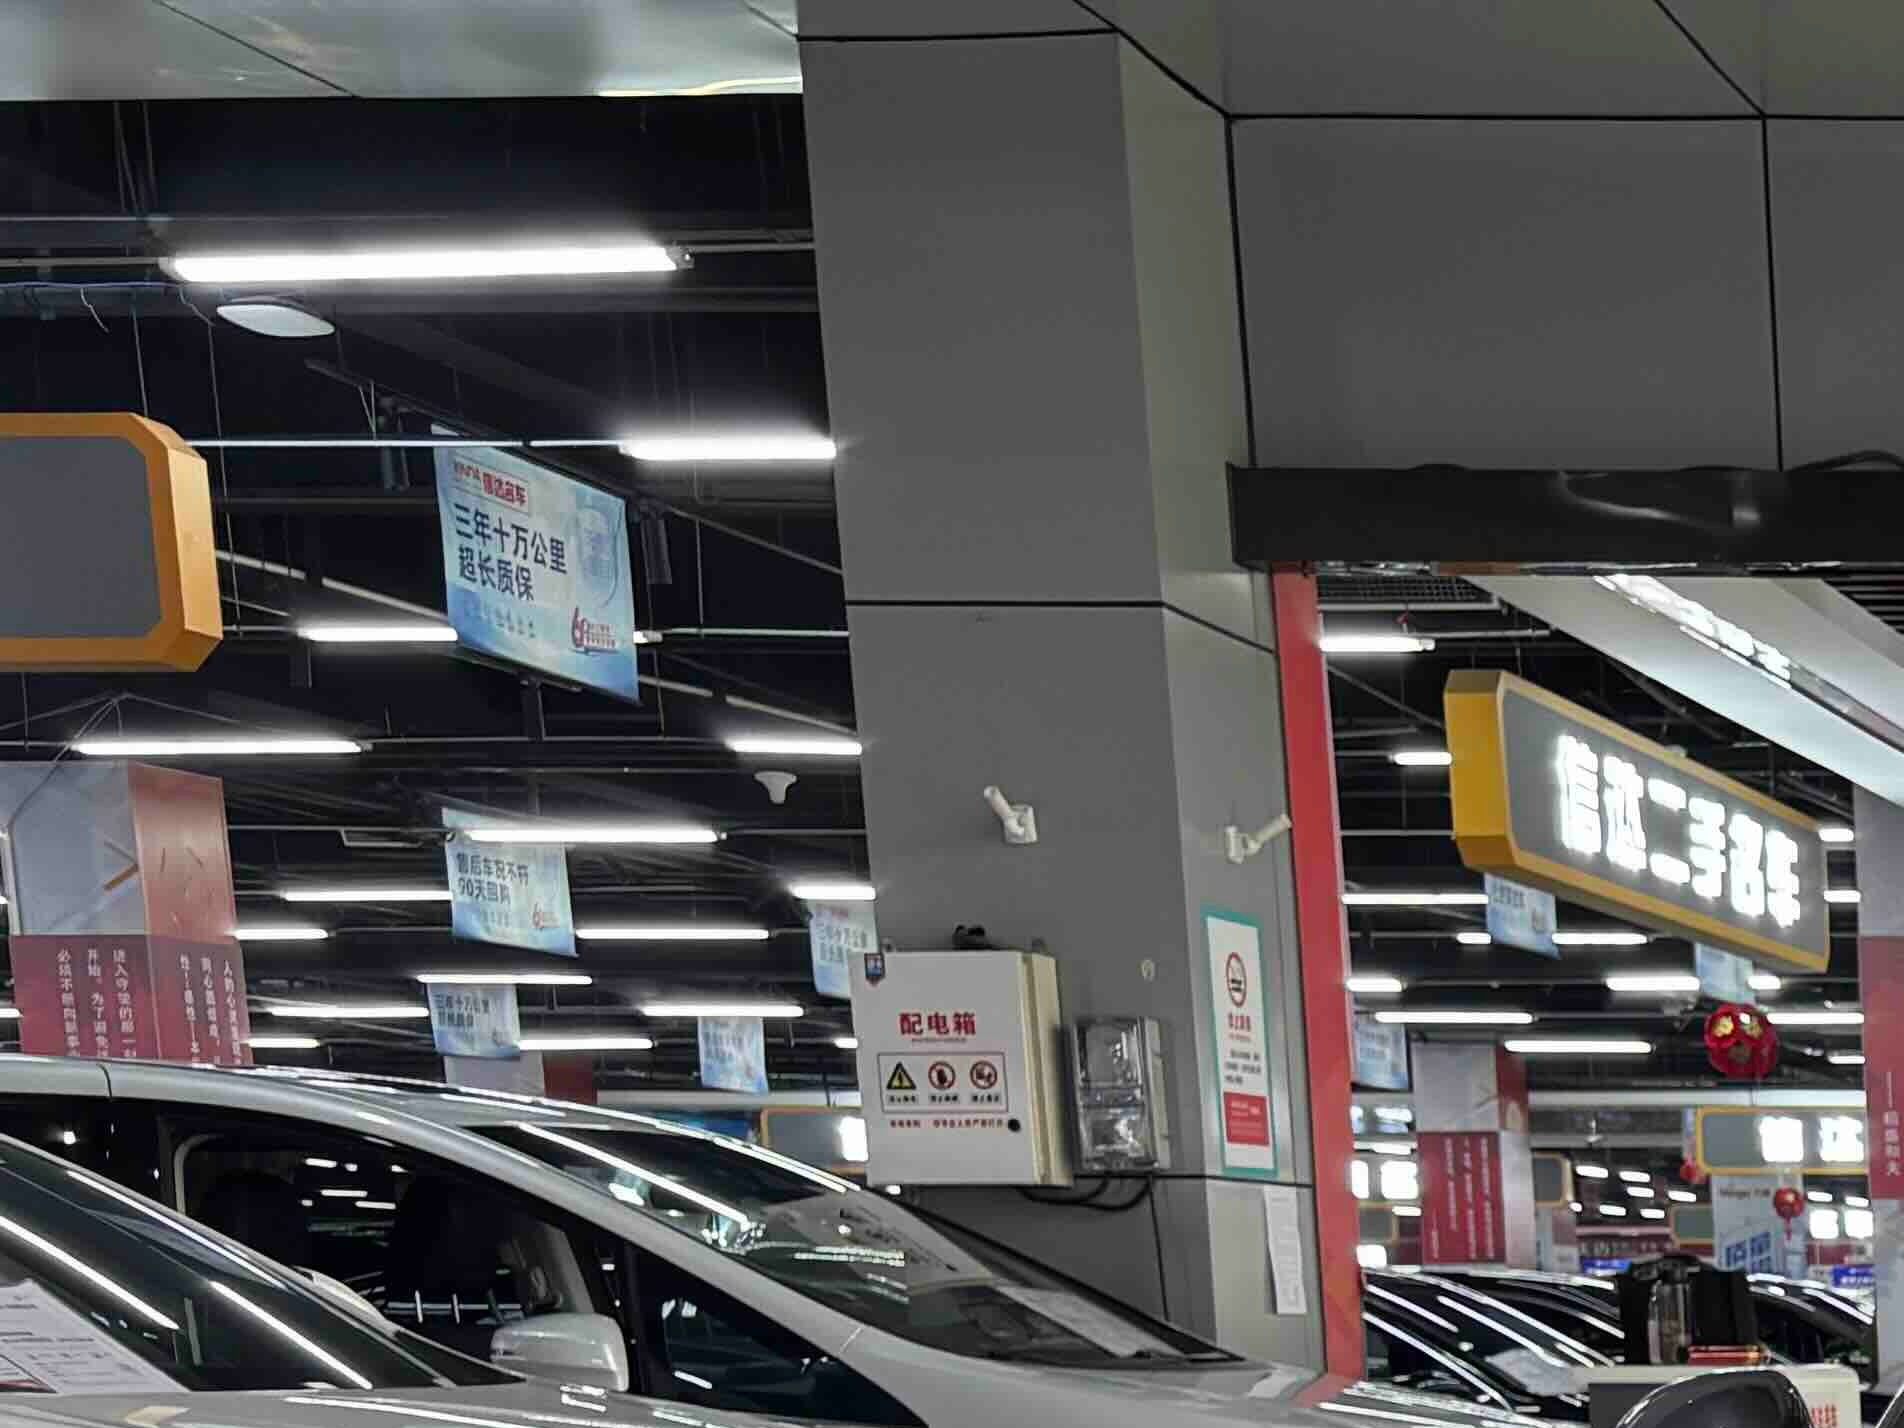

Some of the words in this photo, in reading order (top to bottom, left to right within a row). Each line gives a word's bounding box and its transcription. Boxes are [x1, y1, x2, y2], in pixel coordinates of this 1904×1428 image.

[453, 503, 568, 575] 三年十万公里
[459, 546, 535, 601] 超长质保
[898, 1011, 977, 1036] 配电箱
